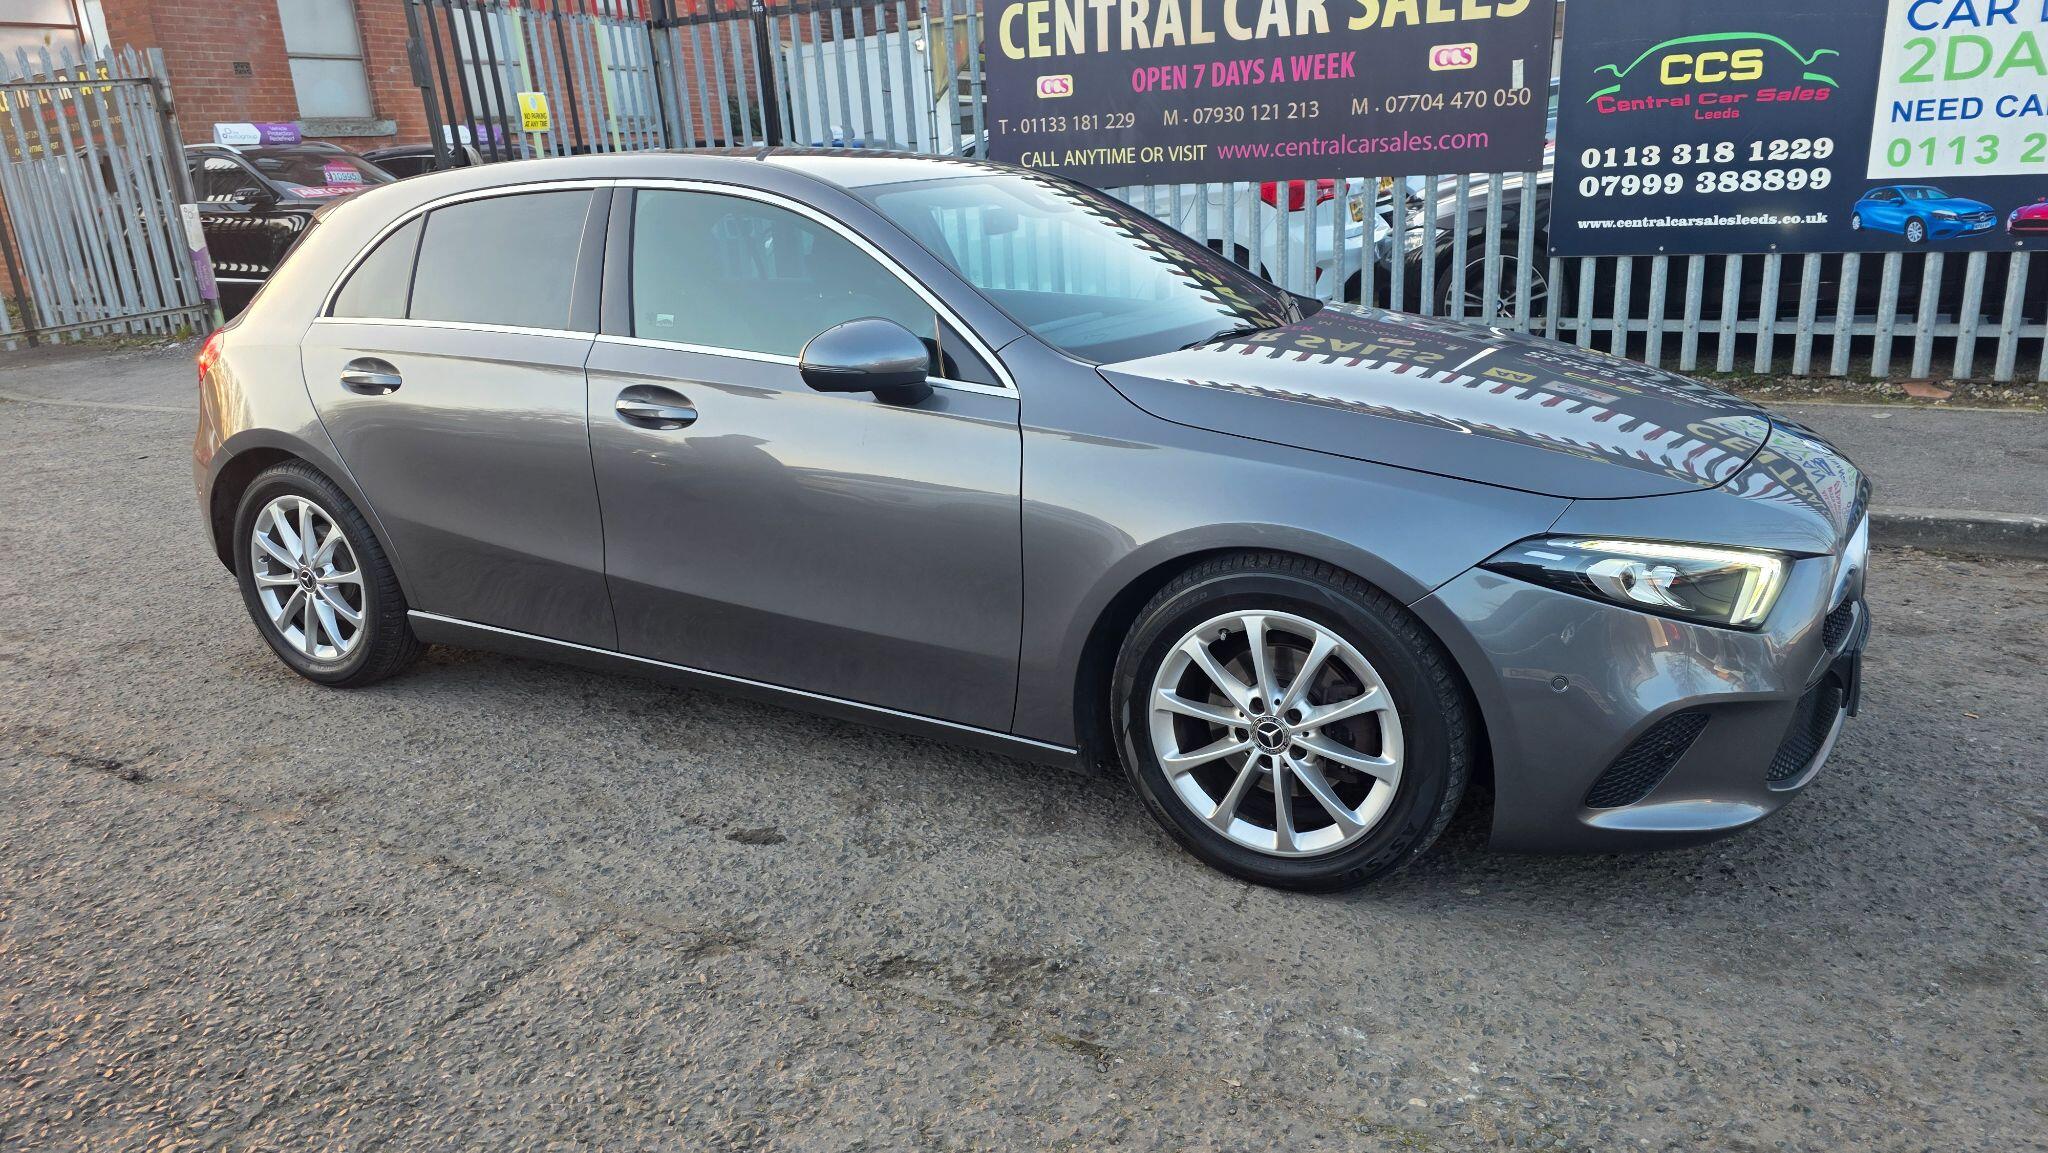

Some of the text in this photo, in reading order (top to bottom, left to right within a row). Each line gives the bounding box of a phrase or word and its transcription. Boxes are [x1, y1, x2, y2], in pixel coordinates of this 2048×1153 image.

[999, 0, 1215, 59] CENTRAL
[1223, 0, 1330, 40] CAR
[1907, 0, 2018, 31] CAR
[1434, 46, 1472, 67] CCS
[1660, 48, 1764, 86] CCS
[1041, 77, 1069, 95] CCS
[1132, 51, 1358, 94] OPEN 7 DAYS A WEEK
[1192, 105, 1245, 125] 07930
[1251, 103, 1279, 121] 121
[1287, 100, 1320, 119] 213
[1385, 93, 1445, 114] 07704
[1450, 90, 1487, 110] 470
[1493, 87, 1532, 107] 050
[1596, 85, 1832, 114] Central Car Sales
[1694, 107, 1740, 120] Leeds
[1891, 94, 2048, 123] NEED CA
[1020, 116, 1067, 135] 01133
[1072, 114, 1098, 131] 181
[1105, 112, 1136, 129] 229
[1021, 130, 1490, 169] CALL ANYTIME OR VISIT www.centralcarsales.com
[1581, 137, 1835, 169] 0113 318 1229
[1886, 134, 2000, 168] 0113
[1578, 167, 1832, 198] 07999 388899
[1577, 212, 1829, 229] www.centralcarsalesleeds.co.uk
